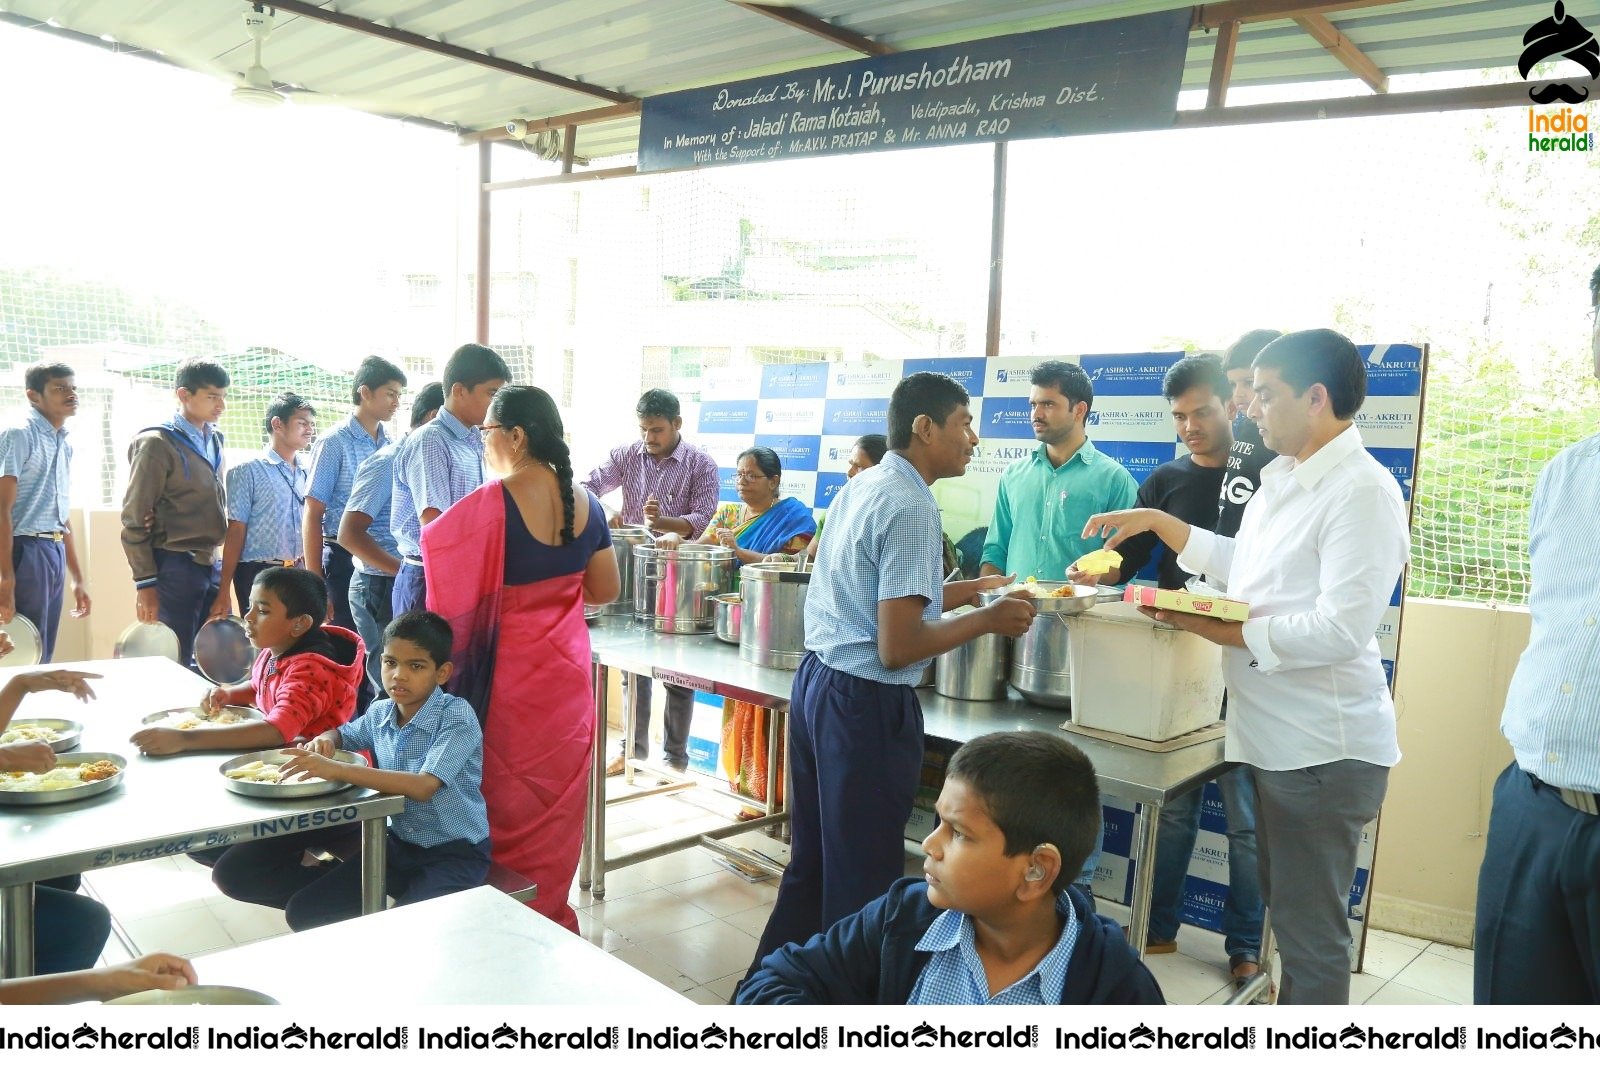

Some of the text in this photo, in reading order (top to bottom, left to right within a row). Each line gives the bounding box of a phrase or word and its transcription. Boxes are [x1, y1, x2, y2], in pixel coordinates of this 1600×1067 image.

[713, 85, 779, 111] Donated
[859, 55, 1011, 97] Purushotham
[663, 136, 672, 150] In
[675, 132, 717, 148] Memory
[744, 112, 788, 139] Jaladi
[789, 111, 825, 134] Rama
[988, 91, 1046, 112] Krishna
[1056, 83, 1105, 105] Dist.
[693, 150, 712, 163] With
[715, 148, 728, 161] the
[729, 142, 765, 162] Support
[831, 129, 877, 149] PRATAP
[883, 128, 896, 144] &
[902, 126, 920, 142] Mr.
[926, 122, 967, 140] ANNA
[975, 117, 1011, 136] RAO
[1380, 361, 1417, 369] AKRUTI
[1230, 440, 1254, 456] OTE
[1129, 457, 1159, 465] AKRUTI
[1227, 456, 1242, 470] OR
[253, 805, 358, 838] INVESCO
[1193, 893, 1225, 909] AKRUTI
